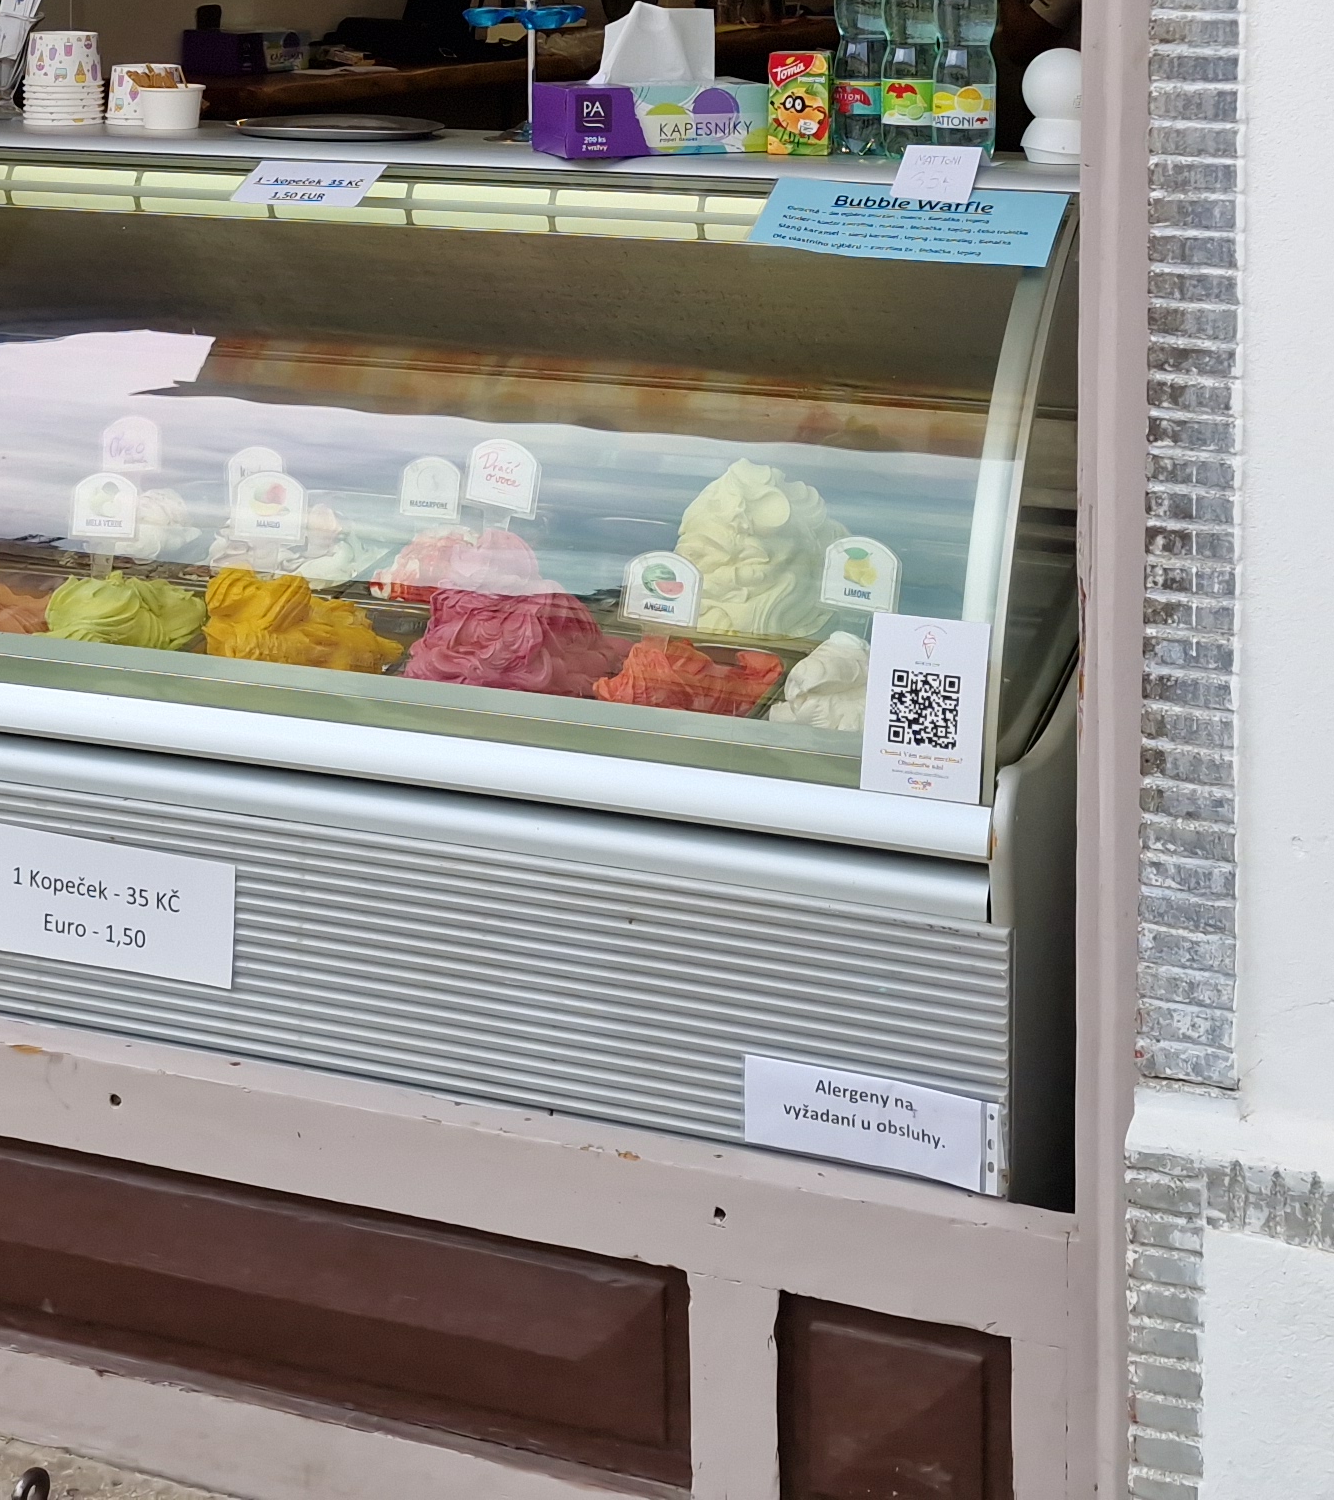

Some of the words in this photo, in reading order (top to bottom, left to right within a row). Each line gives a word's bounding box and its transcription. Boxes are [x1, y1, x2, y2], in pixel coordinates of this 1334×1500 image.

[772, 60, 806, 82] Toma
[583, 101, 605, 117] PA
[659, 116, 754, 138] KAPESNÍKY
[299, 192, 326, 201] EUR
[834, 195, 911, 210] Bubble
[843, 587, 872, 601] LIMONE
[12, 866, 23, 886] 1
[29, 869, 109, 901] Kopeček
[125, 886, 149, 908] 35
[155, 889, 181, 913] KČ
[43, 913, 87, 938] Euro
[104, 924, 147, 949] 1,50
[814, 1078, 890, 1109] Alergeny
[893, 1096, 915, 1112] na
[783, 1102, 857, 1129] vyžadaní
[860, 1118, 872, 1132] u
[876, 1119, 947, 1150] obsluhy.
